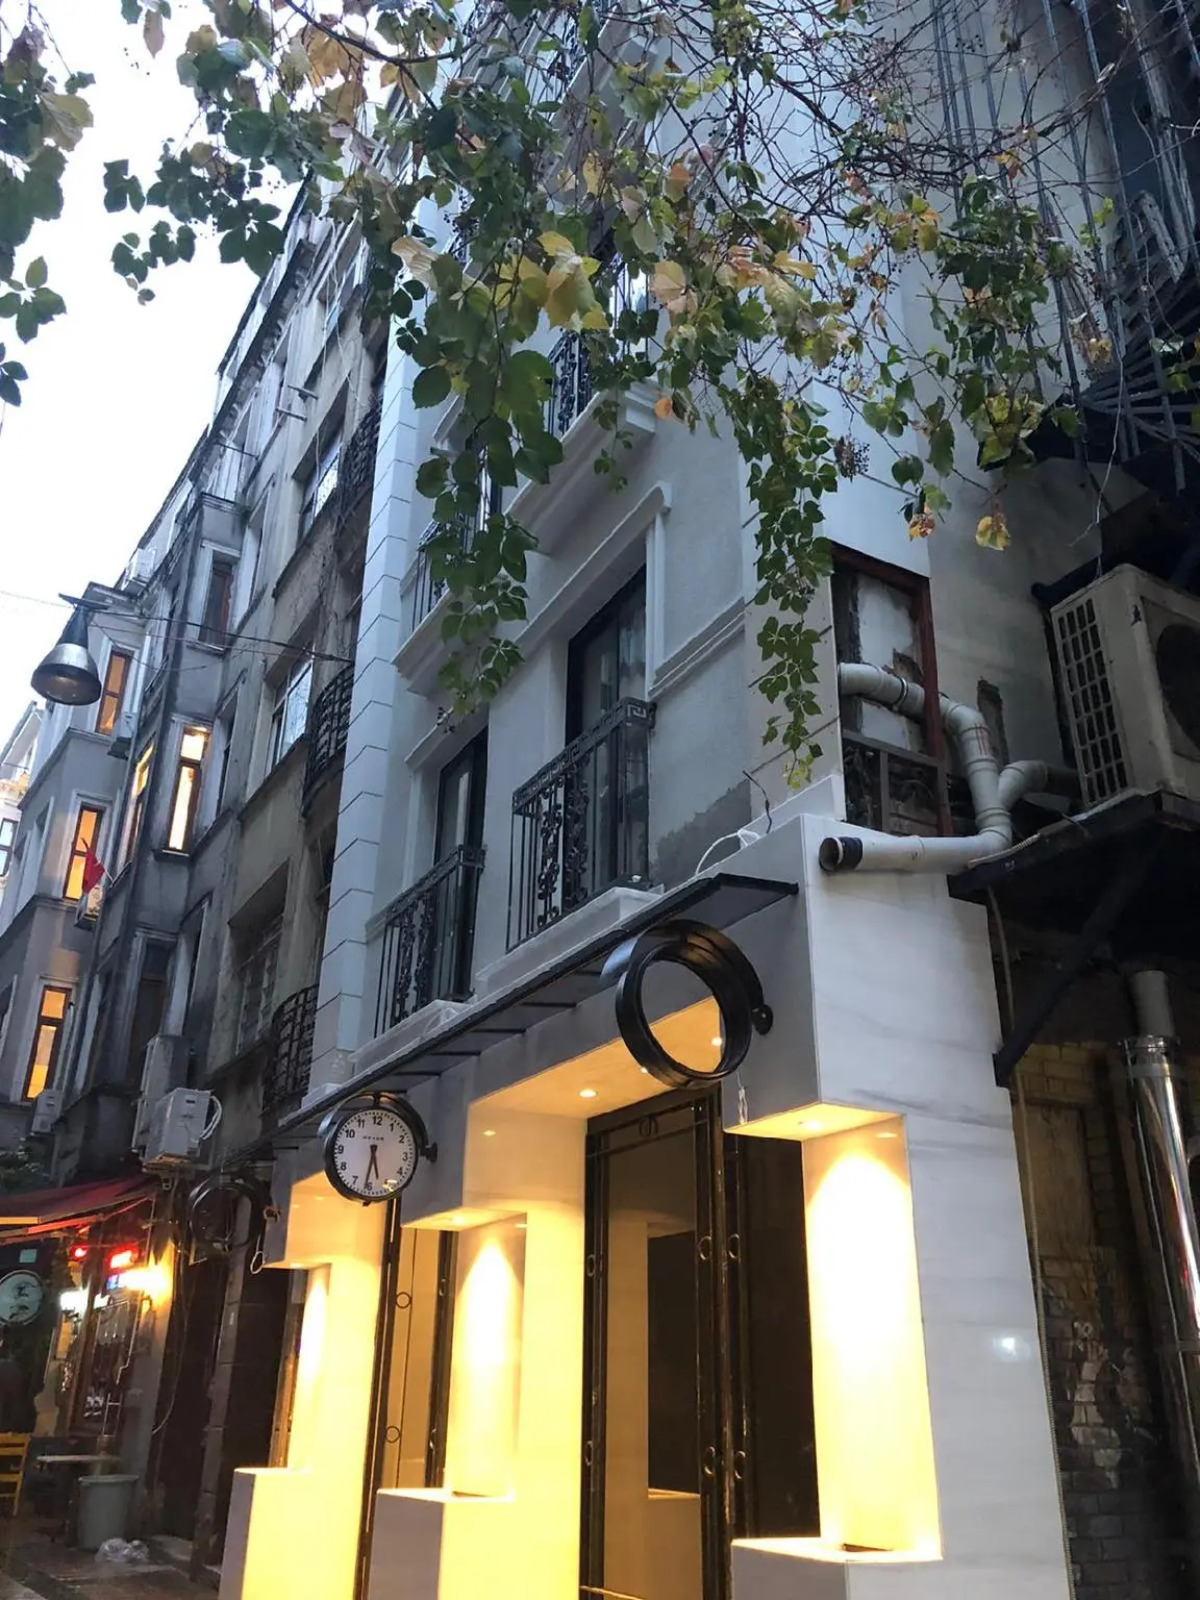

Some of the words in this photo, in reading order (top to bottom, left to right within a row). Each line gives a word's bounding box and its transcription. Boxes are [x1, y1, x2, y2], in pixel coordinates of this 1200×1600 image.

[357, 1118, 365, 1129] 11
[372, 1115, 383, 1126] 12
[389, 1123, 394, 1132] 1
[345, 1129, 355, 1138] 10
[398, 1135, 405, 1144] 2
[337, 1145, 344, 1154] 9
[402, 1152, 408, 1161] 3
[340, 1162, 347, 1171] 8
[397, 1167, 403, 1176] 4
[352, 1176, 358, 1185] 7
[366, 1181, 373, 1191] 6
